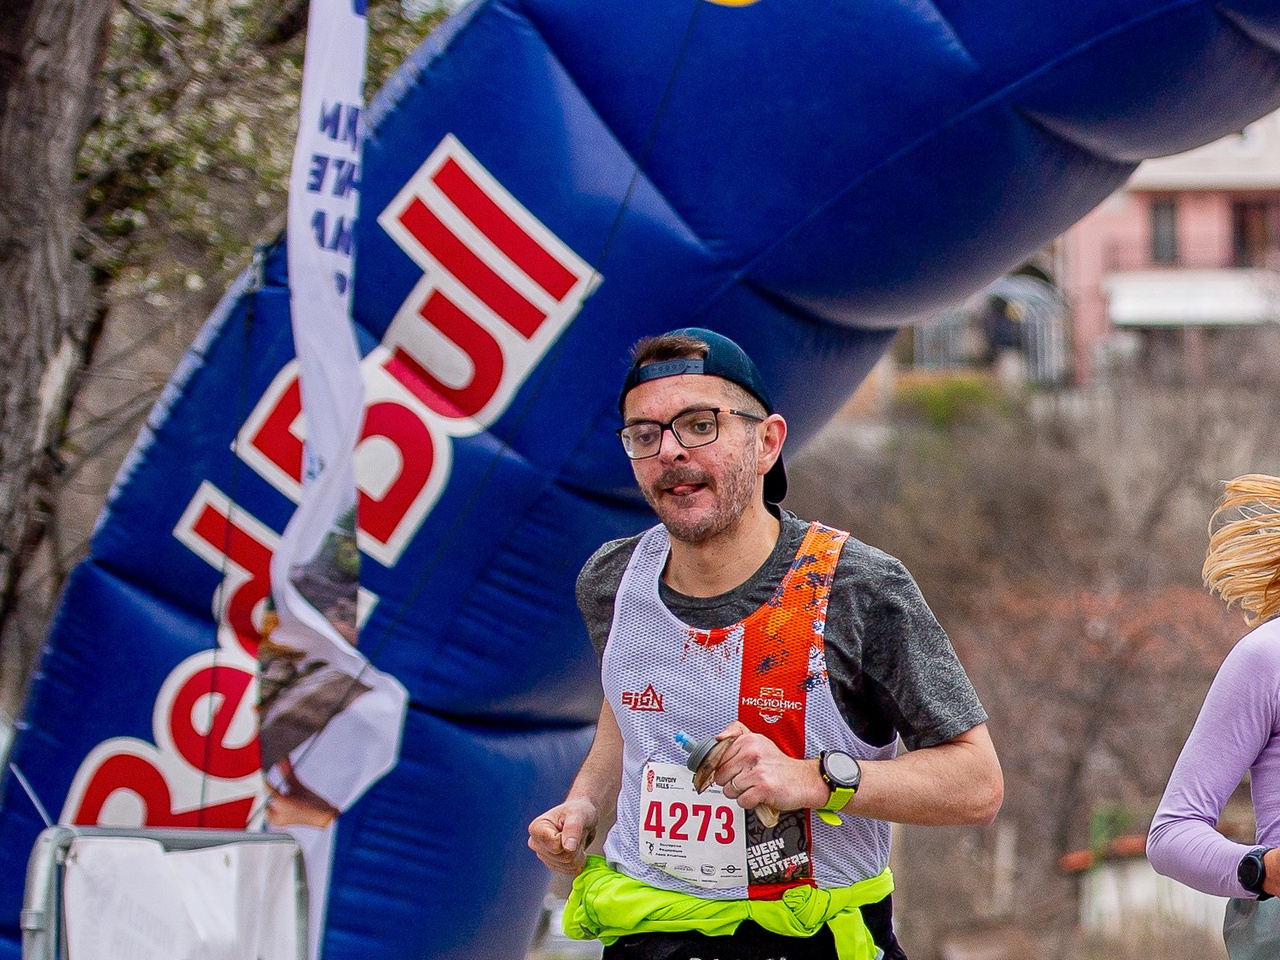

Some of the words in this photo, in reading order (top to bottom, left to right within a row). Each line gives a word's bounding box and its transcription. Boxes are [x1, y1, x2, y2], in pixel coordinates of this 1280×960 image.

[245, 148, 590, 555] Bull
[741, 697, 803, 710] МИСИОНИС
[643, 800, 736, 844] 4273
[747, 851, 780, 870] STEP
[751, 852, 809, 879] MATTERS
